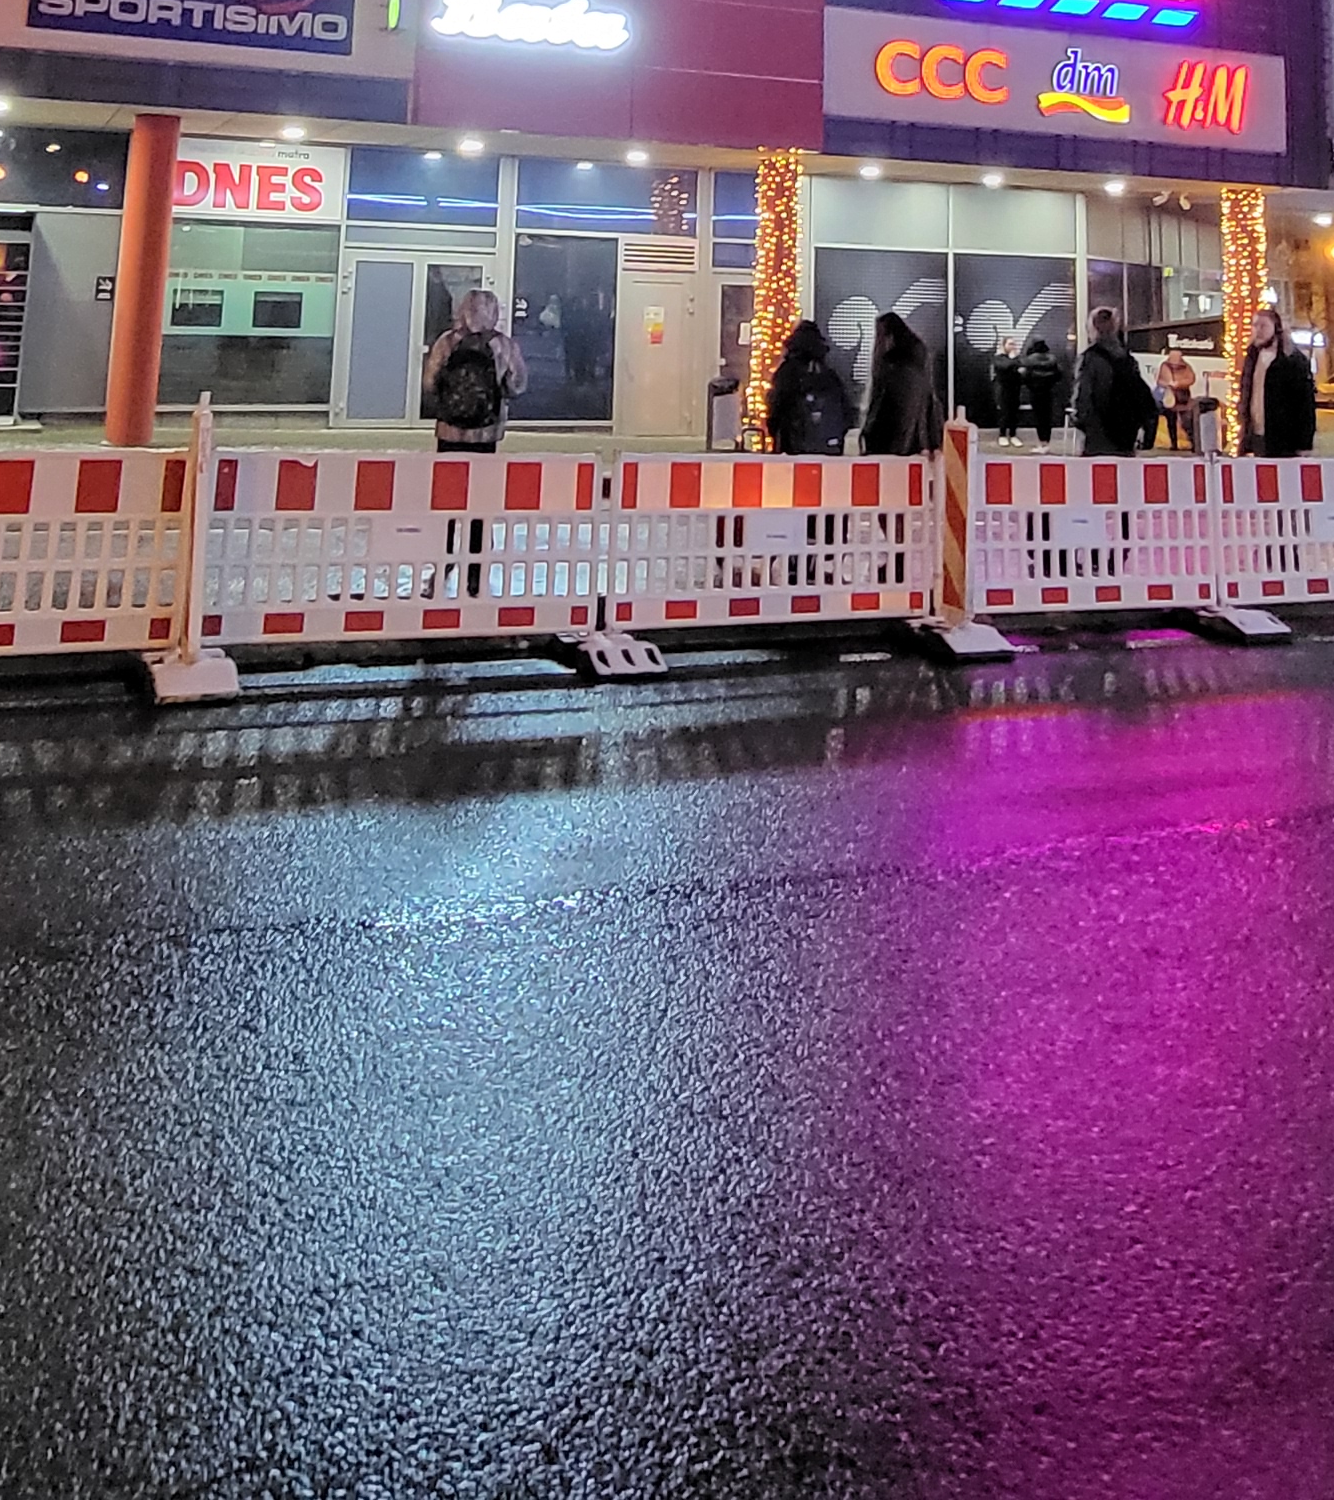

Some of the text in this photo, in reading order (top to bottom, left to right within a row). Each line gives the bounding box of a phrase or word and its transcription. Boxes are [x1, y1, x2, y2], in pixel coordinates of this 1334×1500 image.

[874, 38, 1010, 104] CCC
[1051, 47, 1119, 97] dm
[1163, 58, 1251, 136] H&M
[172, 160, 324, 212] DNES
